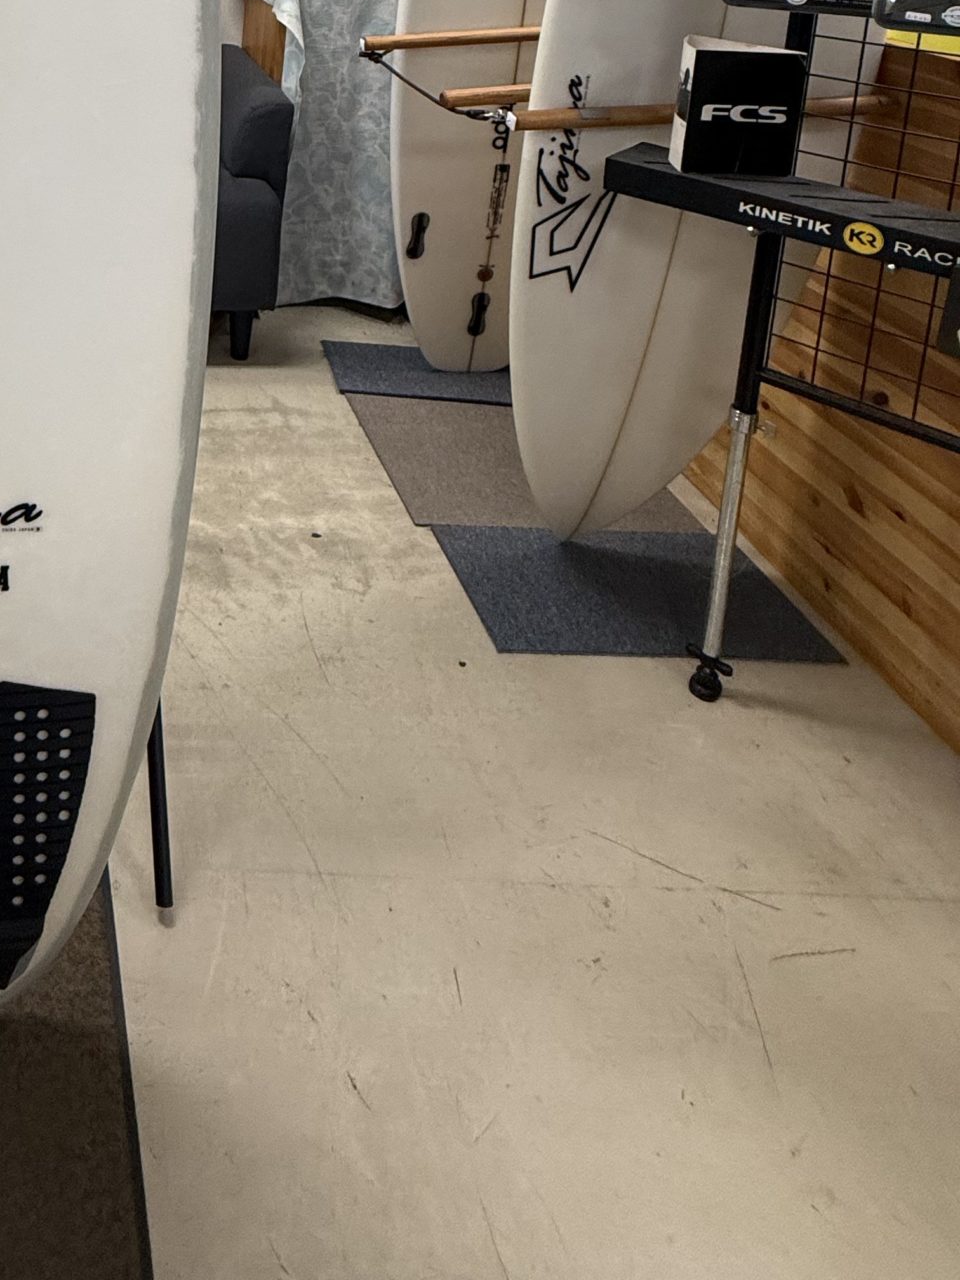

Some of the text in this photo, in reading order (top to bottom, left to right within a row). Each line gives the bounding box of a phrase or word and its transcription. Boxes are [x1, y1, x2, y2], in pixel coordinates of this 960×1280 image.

[700, 103, 788, 125] FCS
[738, 201, 833, 236] KINETIK
[893, 241, 960, 267] RAC
